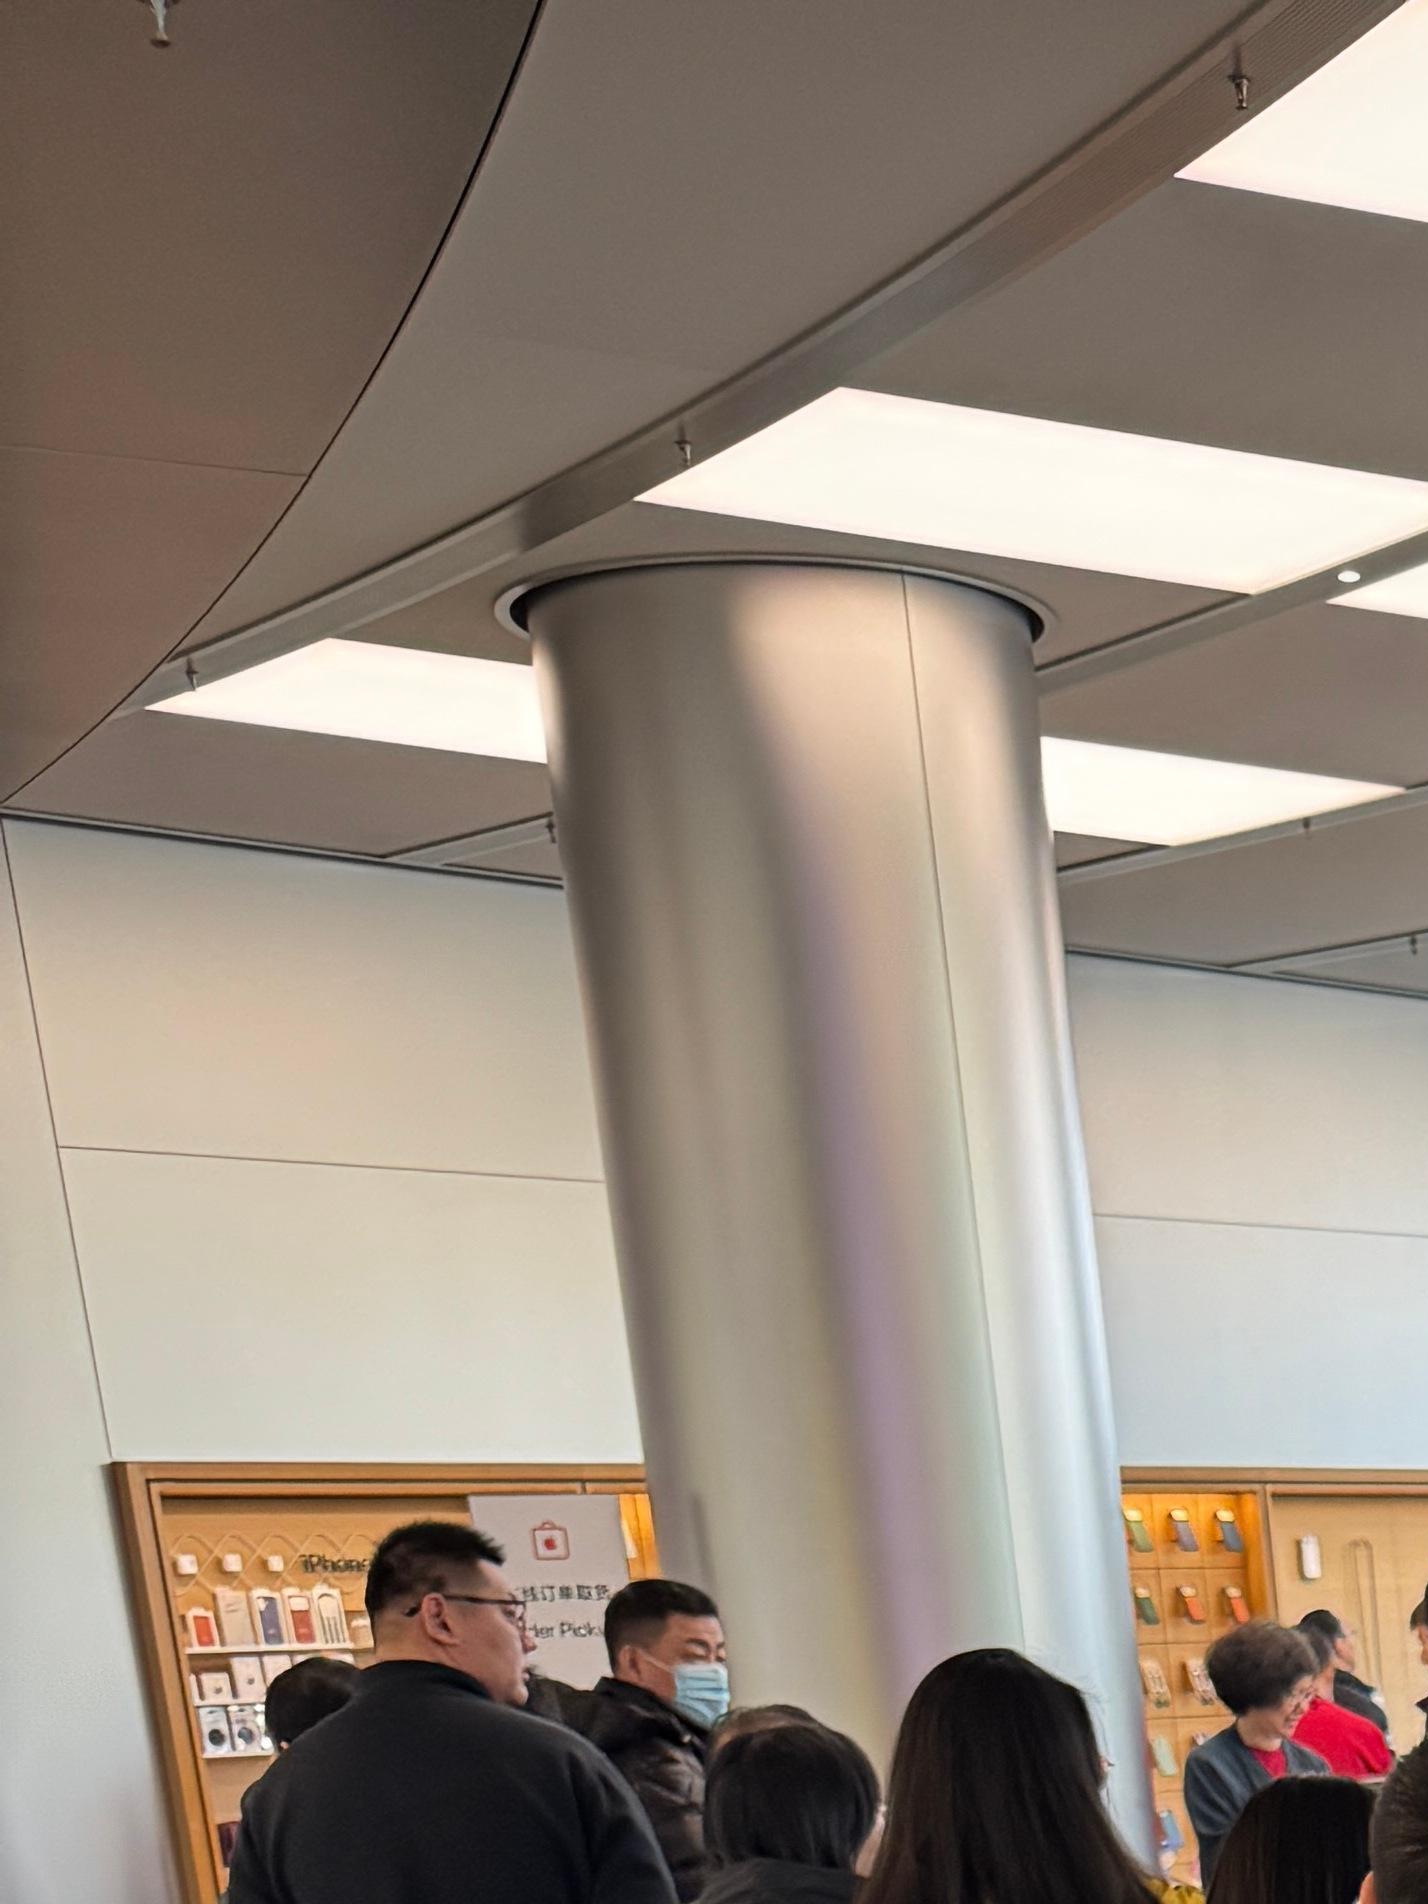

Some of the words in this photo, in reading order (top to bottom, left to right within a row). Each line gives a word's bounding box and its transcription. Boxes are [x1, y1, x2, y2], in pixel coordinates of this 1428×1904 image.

[514, 1583, 609, 1602] 线订单取货
